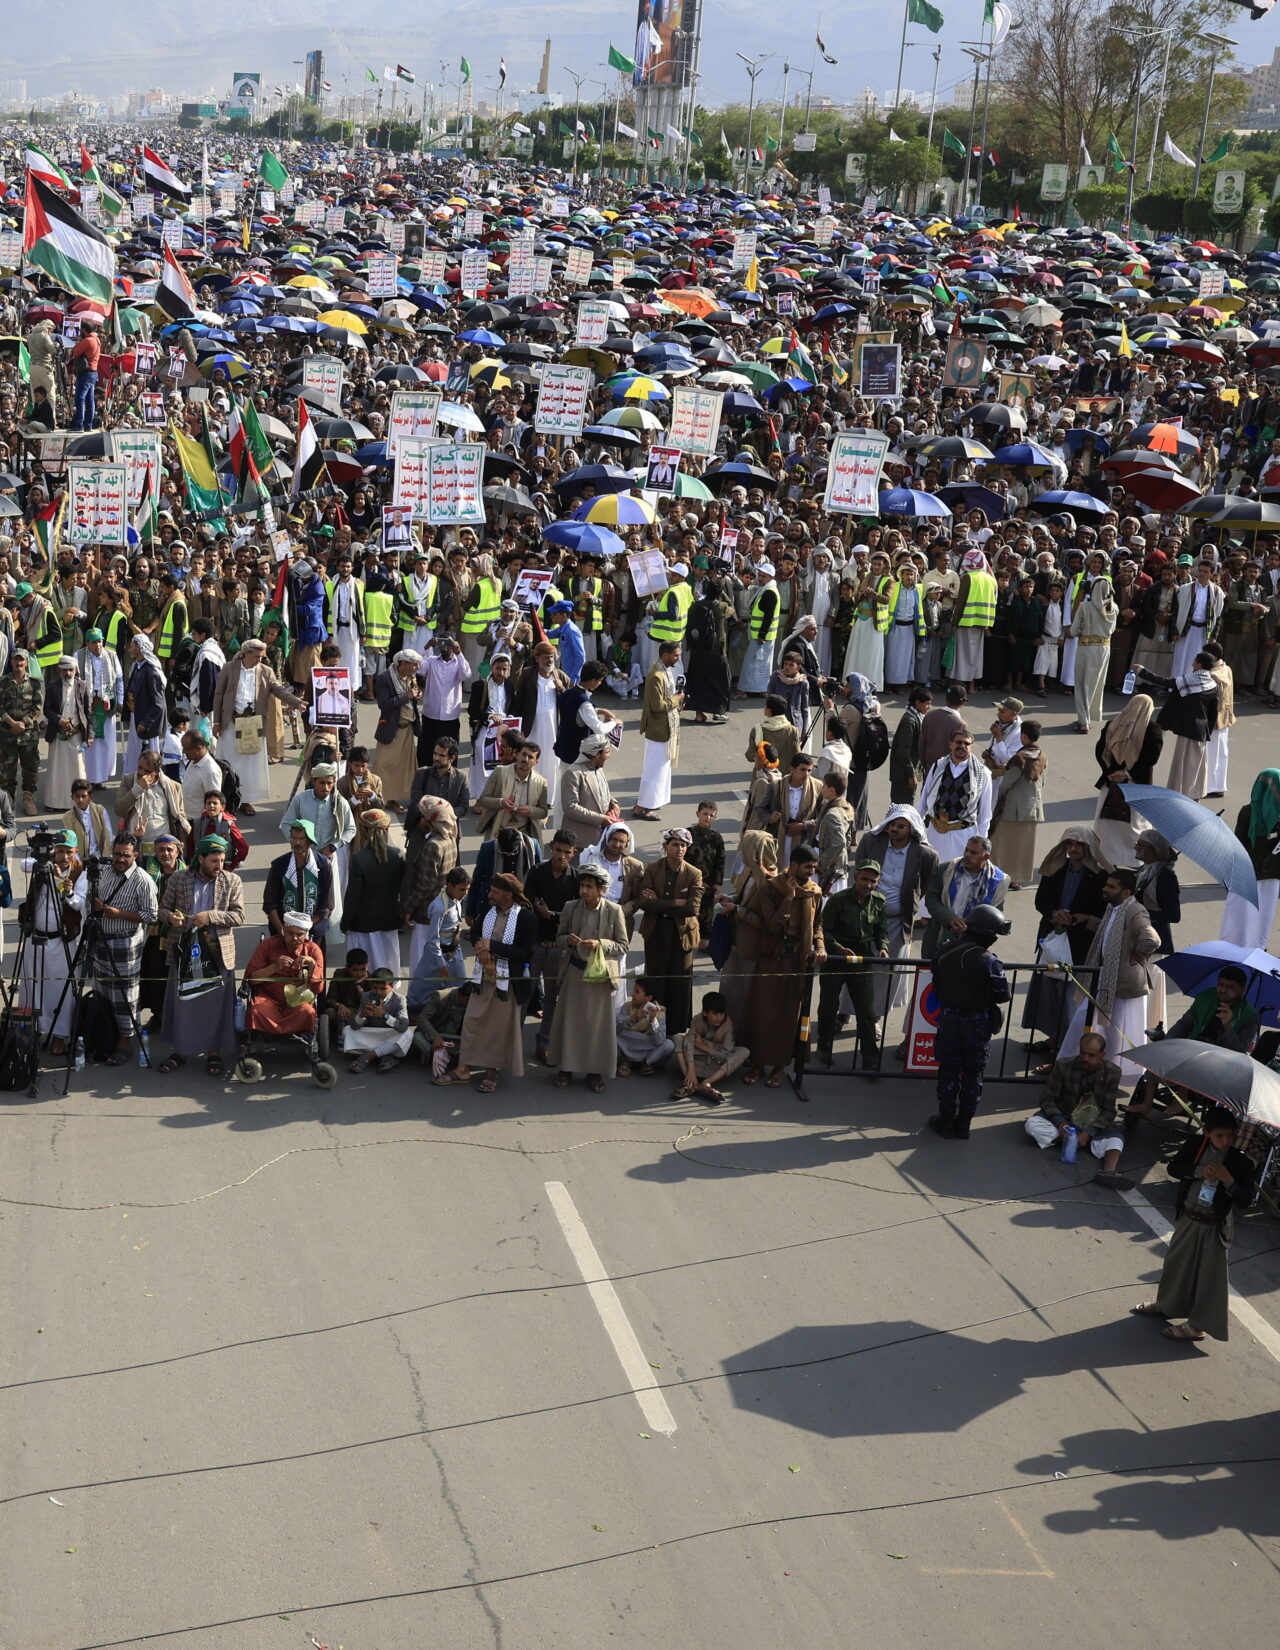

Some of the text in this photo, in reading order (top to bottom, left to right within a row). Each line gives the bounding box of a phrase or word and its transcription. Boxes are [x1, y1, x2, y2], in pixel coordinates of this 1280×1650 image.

[403, 448, 428, 461] كبر
[462, 449, 480, 462] الله
[460, 466, 478, 475] الموت
[104, 472, 122, 484] الله
[459, 480, 477, 488] الموت
[101, 490, 122, 499] الموت
[432, 492, 451, 502] اليهود
[452, 494, 461, 502] على
[101, 502, 122, 512] الموت
[457, 503, 479, 518] النصر
[74, 516, 94, 526] اليهود
[94, 518, 103, 526] على
[100, 528, 121, 542] النصر
